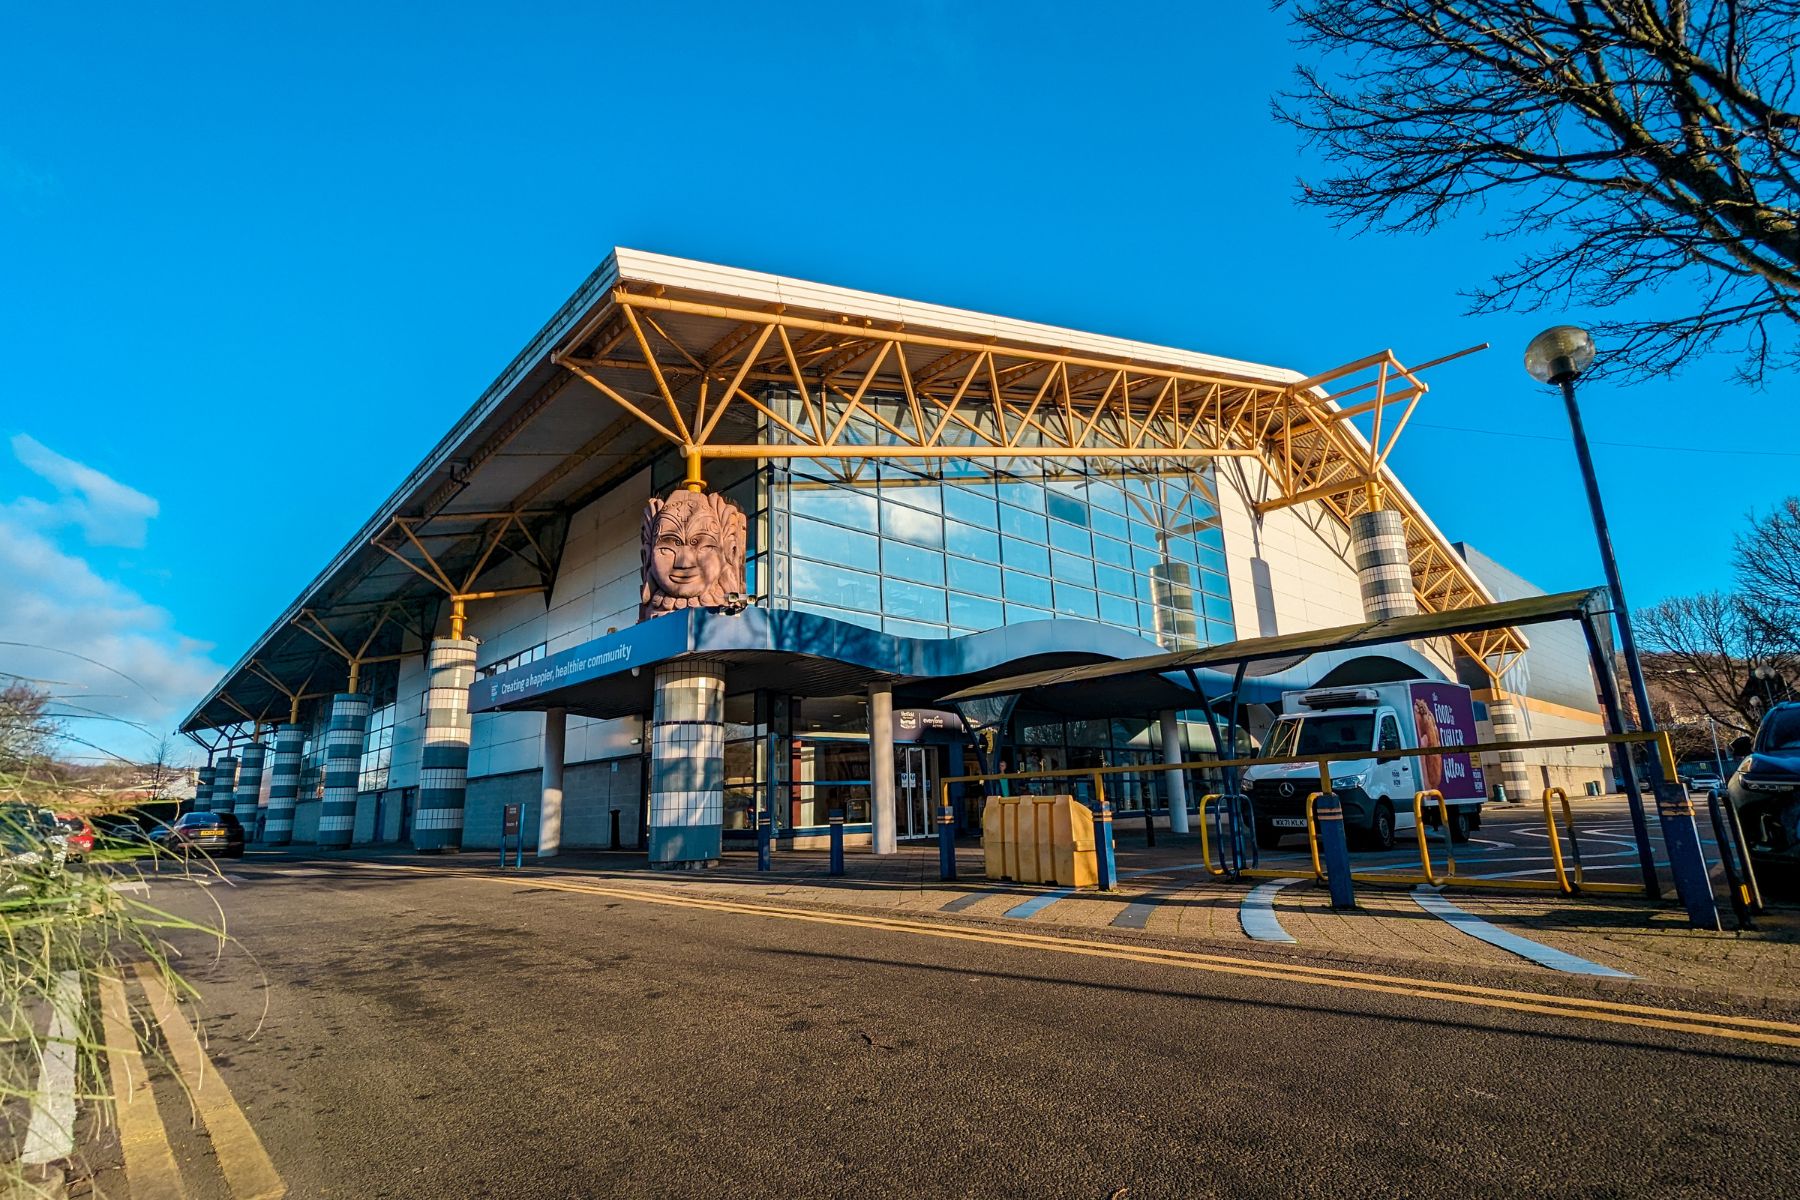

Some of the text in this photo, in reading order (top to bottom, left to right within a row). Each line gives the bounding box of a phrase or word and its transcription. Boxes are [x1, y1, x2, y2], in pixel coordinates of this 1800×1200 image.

[502, 678, 525, 694] Creating
[525, 678, 530, 687] a
[530, 669, 555, 687] happier,
[555, 659, 586, 678] healthier
[588, 644, 632, 668] community
[1434, 703, 1451, 724] FOOD
